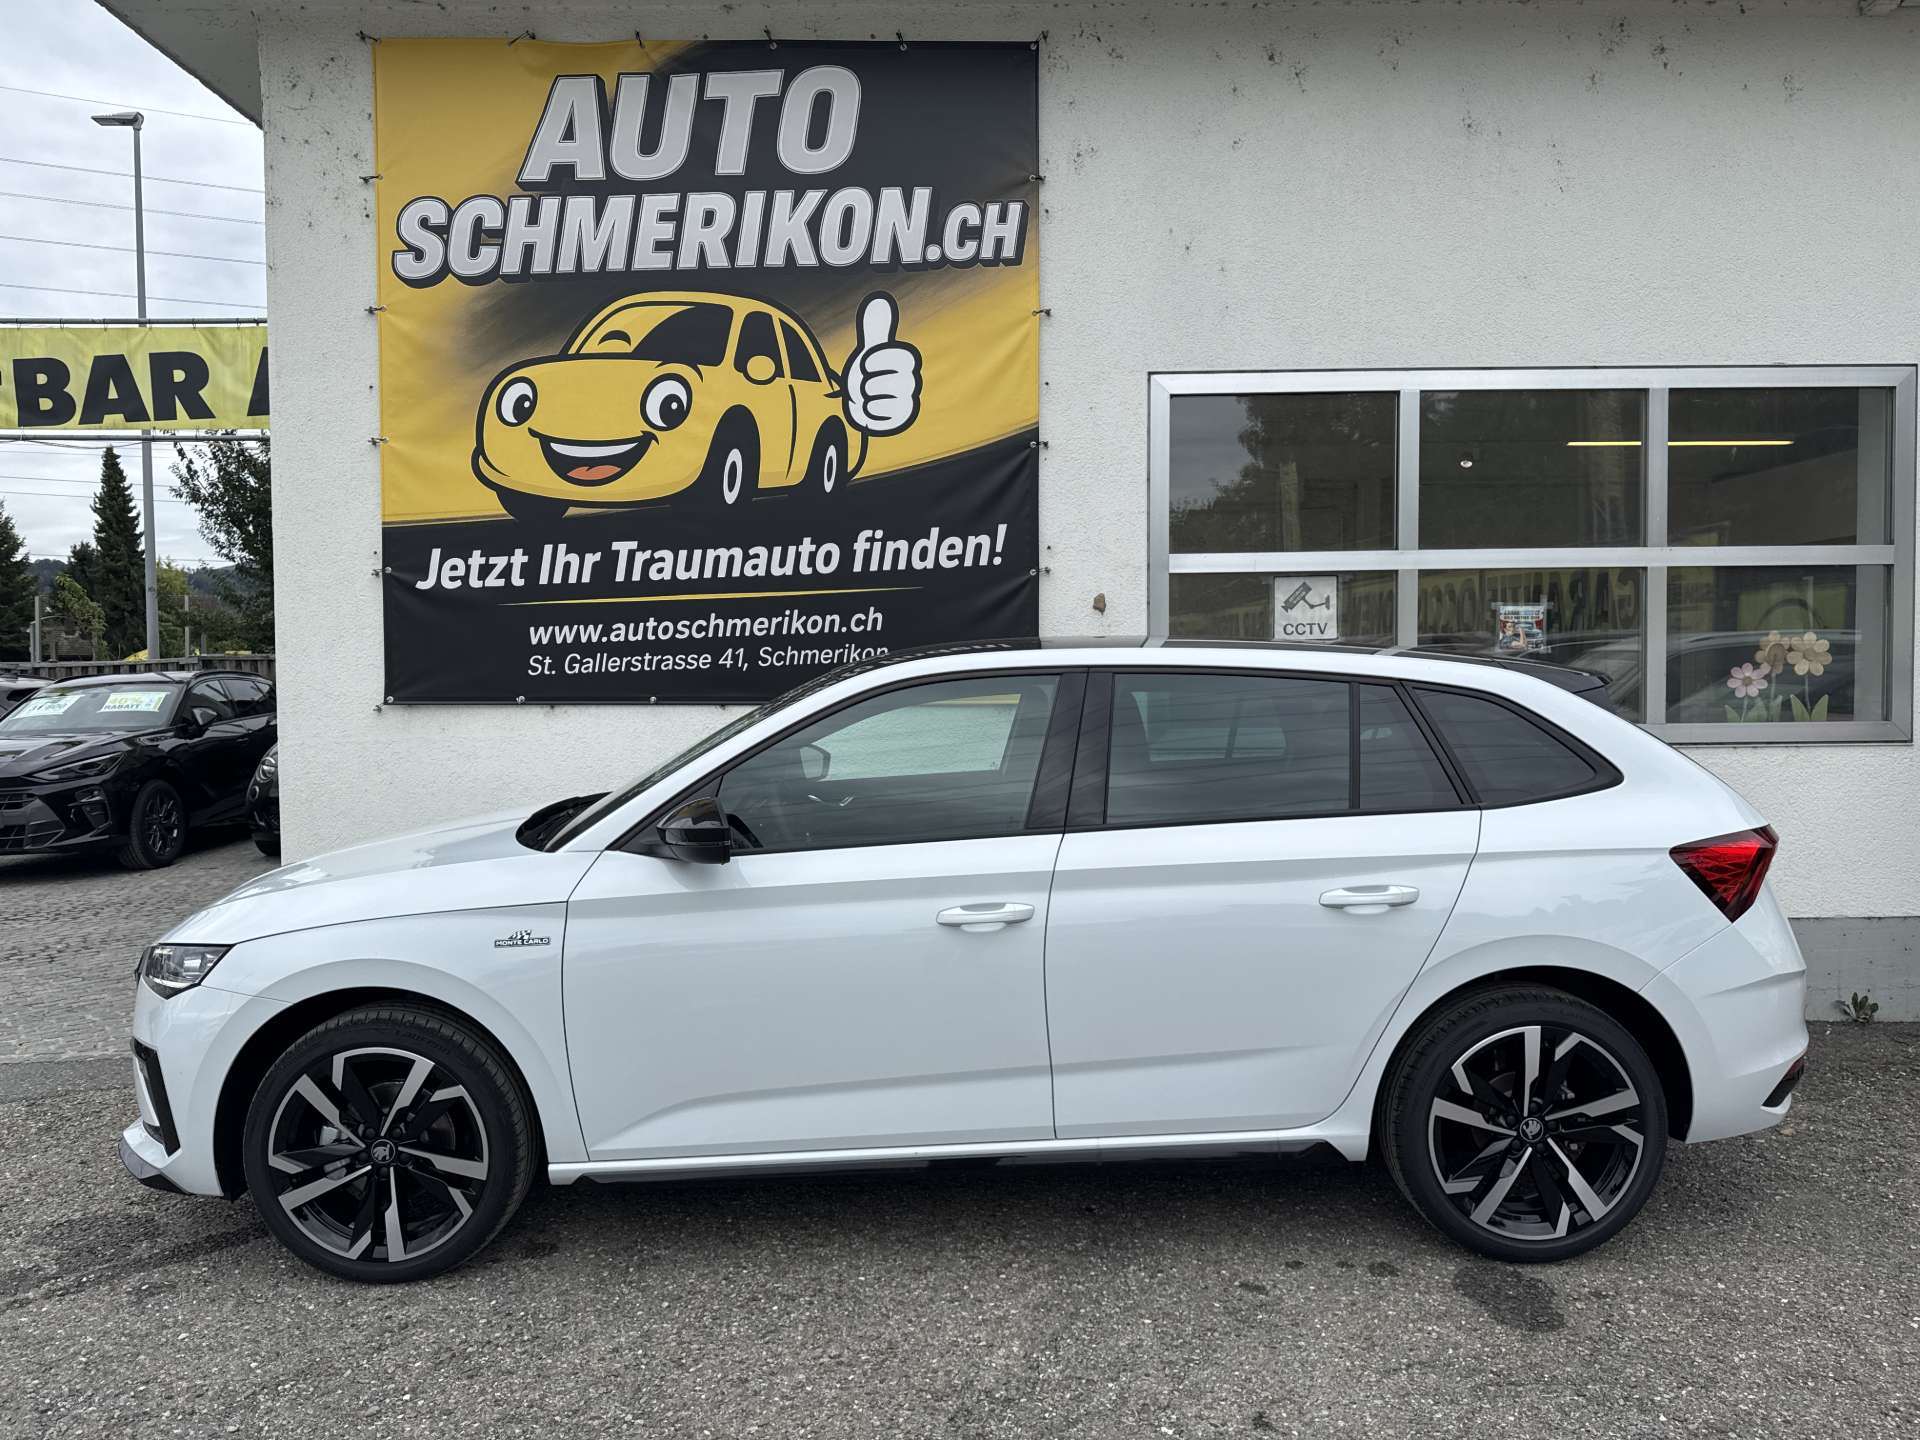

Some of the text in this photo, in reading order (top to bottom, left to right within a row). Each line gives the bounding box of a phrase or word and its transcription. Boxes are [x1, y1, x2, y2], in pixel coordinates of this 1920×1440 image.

[517, 63, 863, 186] AUTO
[392, 184, 1028, 284] SCHMERIKON.CH
[0, 351, 216, 427] BAR
[415, 523, 1008, 590] Jetzt Ihr Traumauto finden!
[529, 606, 883, 645] www.autoschmerikon.ch
[1283, 622, 1328, 636] CCTV
[527, 653, 556, 676] St.
[564, 652, 712, 675] Gallerstrasse
[718, 647, 749, 672] 41,
[758, 643, 889, 667] Schmerikon
